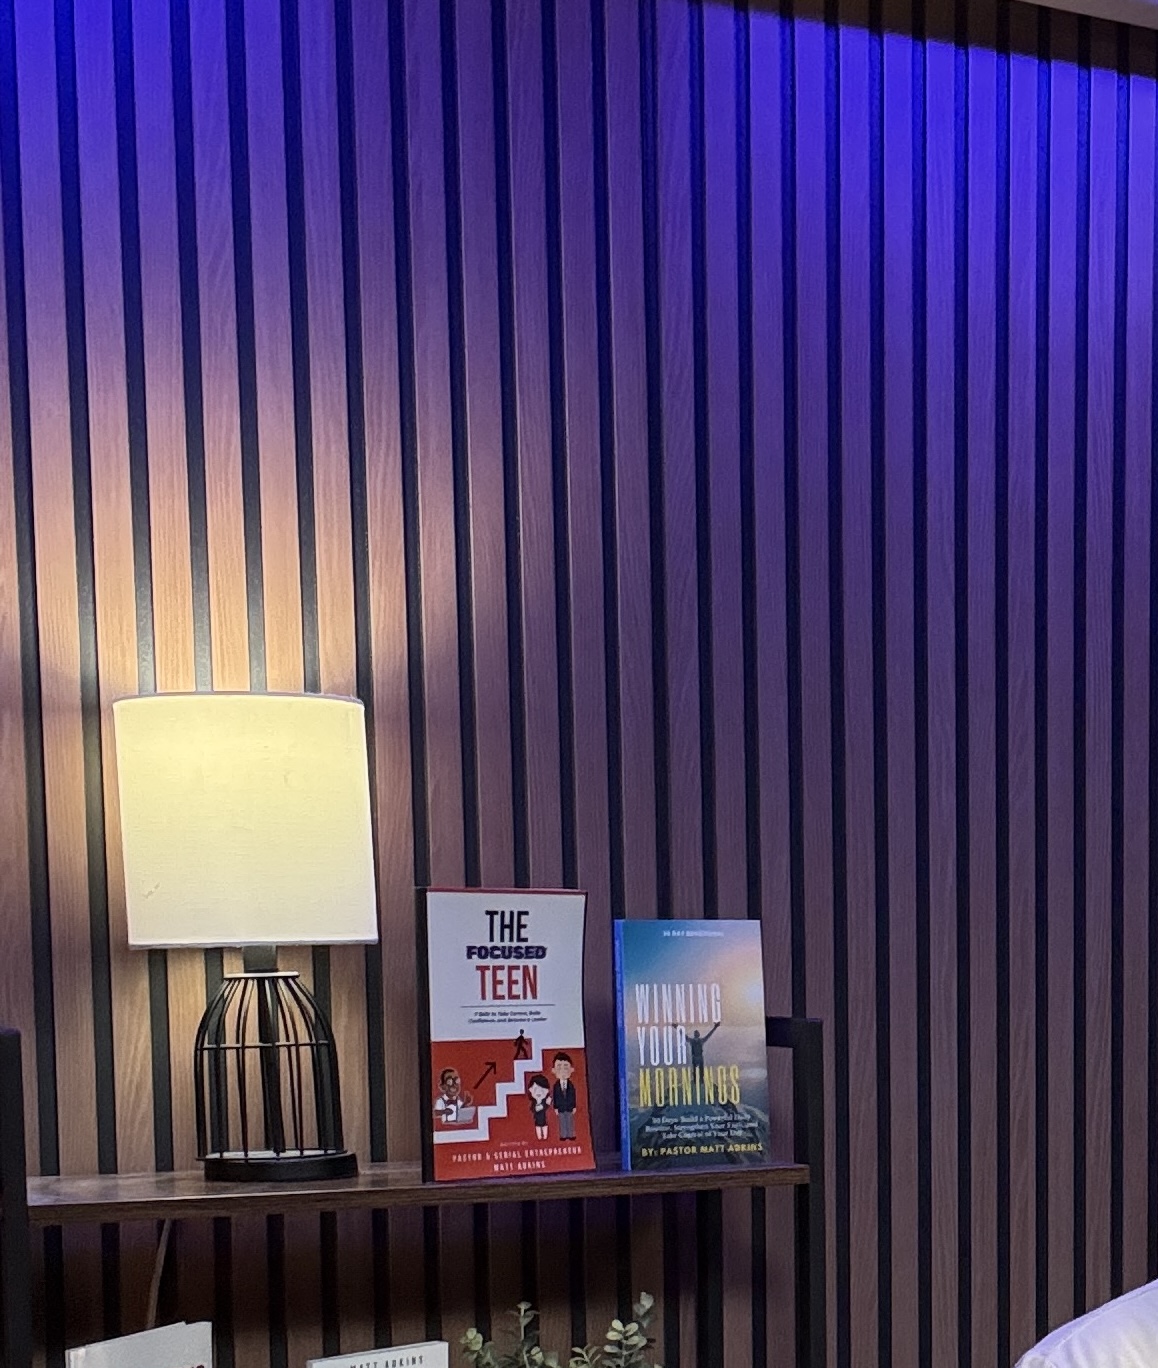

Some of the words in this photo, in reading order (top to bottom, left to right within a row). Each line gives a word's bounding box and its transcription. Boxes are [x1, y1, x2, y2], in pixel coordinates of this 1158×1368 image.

[485, 910, 530, 943] THE
[466, 945, 547, 960] FOCUSED
[475, 964, 538, 1001] TEEN
[635, 983, 721, 1024] WINNING
[637, 1025, 687, 1067] YOUR
[639, 1064, 741, 1108] MORNINGS
[660, 1145, 698, 1156] PASTOR
[699, 1144, 726, 1154] MATT
